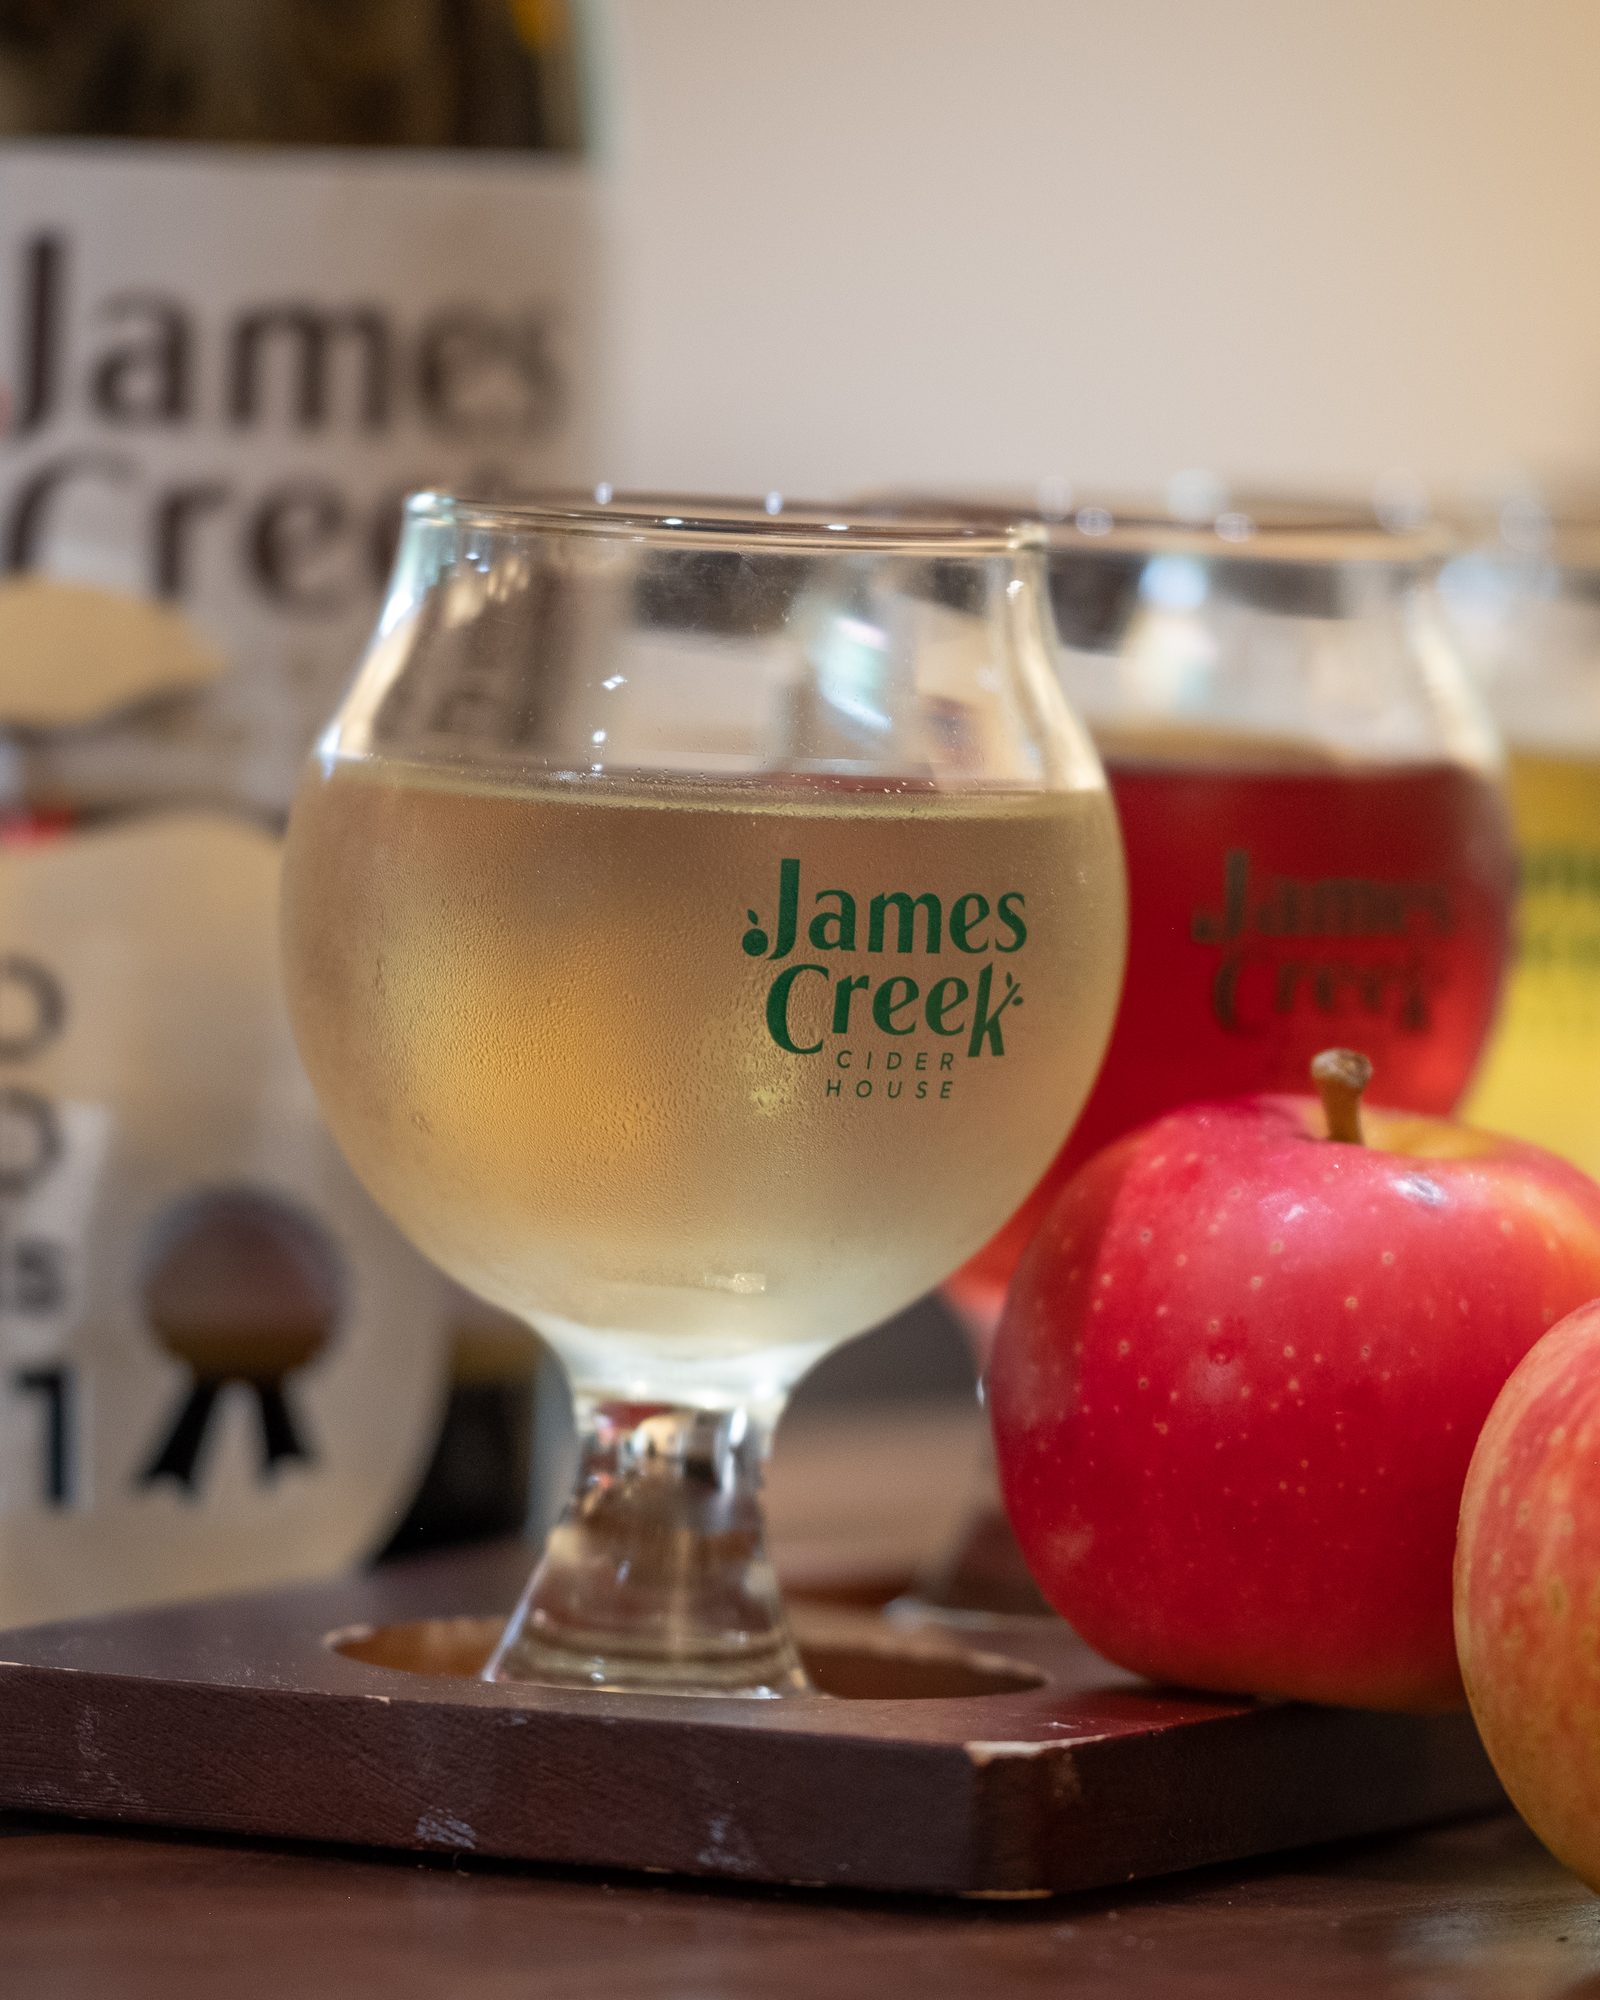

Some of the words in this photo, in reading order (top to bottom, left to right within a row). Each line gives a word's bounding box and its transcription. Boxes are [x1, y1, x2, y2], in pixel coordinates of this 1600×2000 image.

[742, 858, 1028, 960] James
[765, 962, 1024, 1058] Creek
[826, 1079, 954, 1099] HOUSE
[836, 1050, 955, 1071] CIDER
